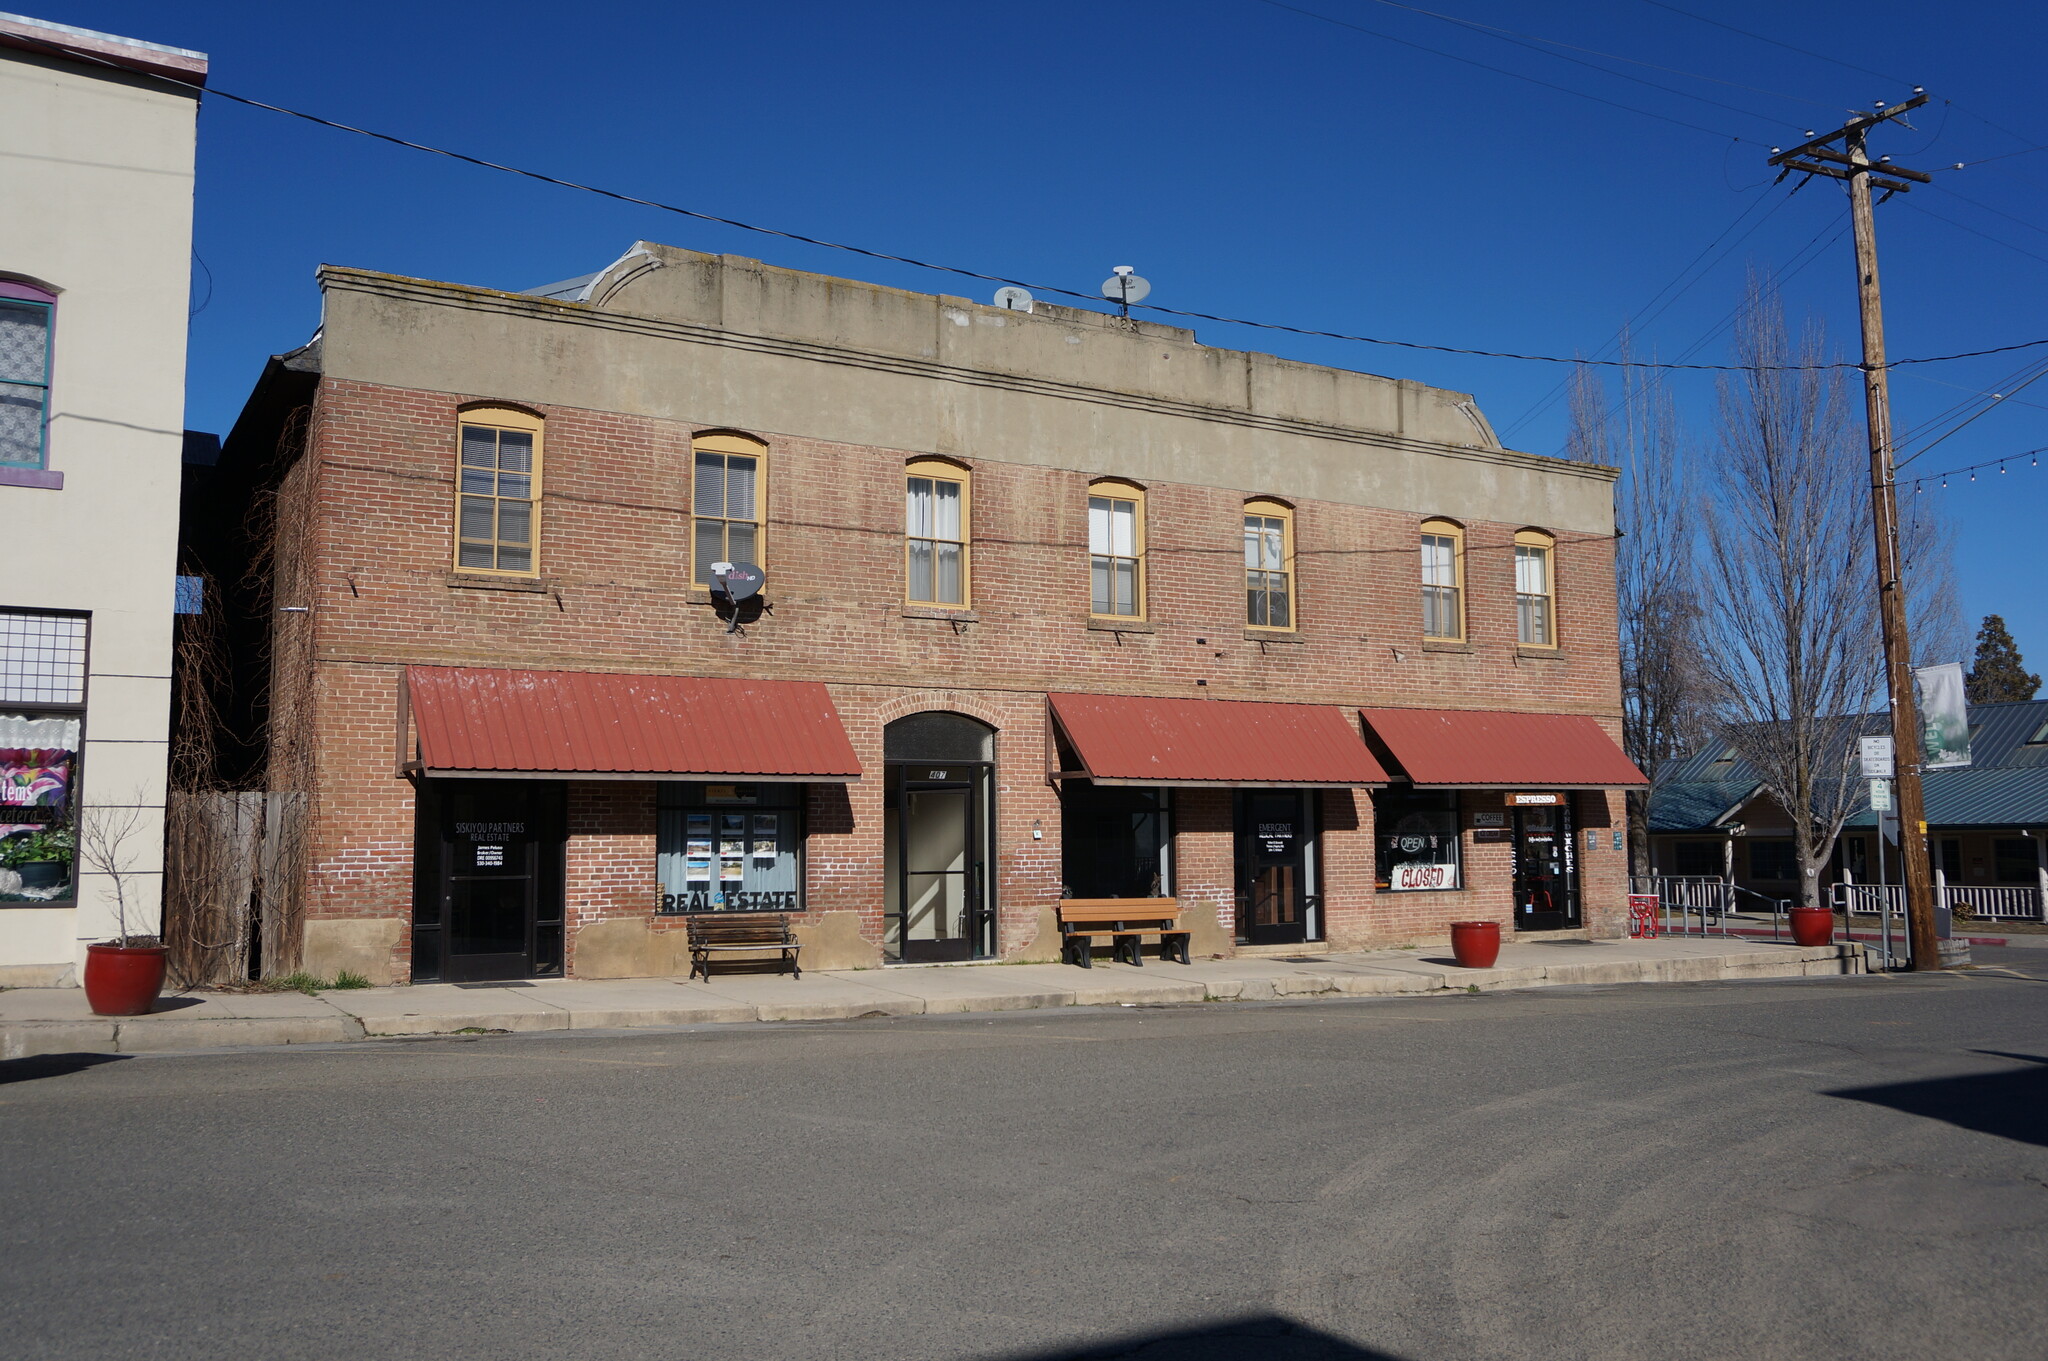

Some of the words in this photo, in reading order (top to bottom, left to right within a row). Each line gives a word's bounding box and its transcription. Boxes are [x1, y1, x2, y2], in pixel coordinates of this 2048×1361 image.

[930, 771, 946, 779] 407
[1515, 795, 1557, 804] ESPRESSO
[1481, 813, 1503, 821] COFFEE
[455, 822, 488, 833] SISKIYOU
[488, 822, 525, 833] PARTNERS
[1259, 824, 1291, 832] EMERGENT
[1400, 837, 1425, 848] OPEN
[1563, 803, 1574, 873] ANDWICHES
[1400, 867, 1444, 888] CLOSED
[664, 890, 714, 912] REAL
[725, 890, 797, 911] ESTATE
